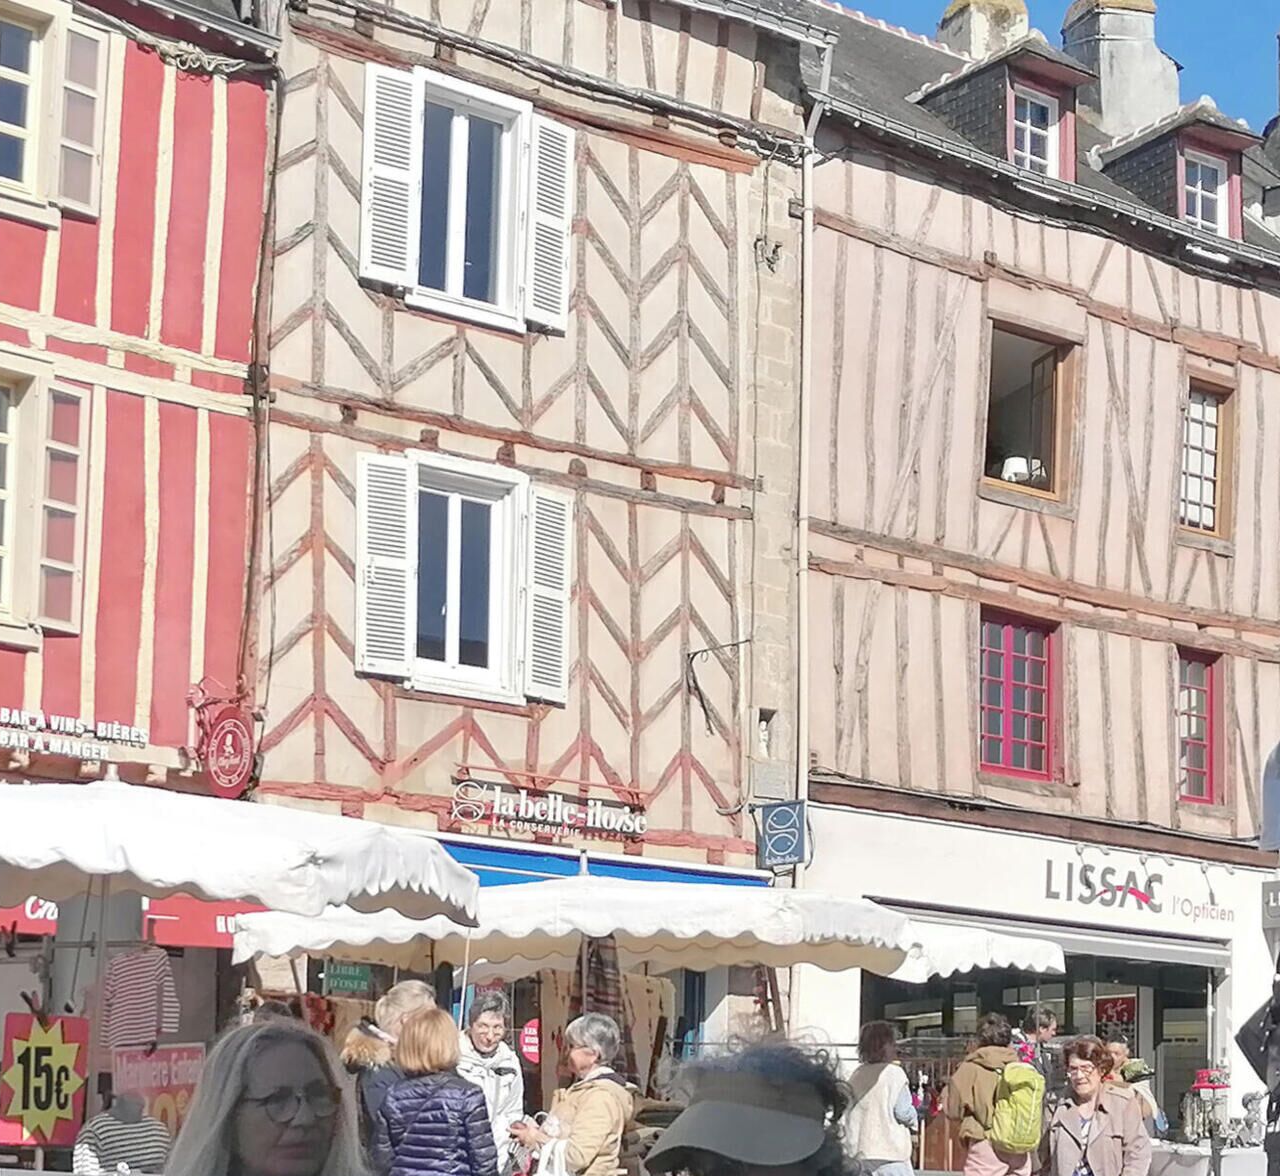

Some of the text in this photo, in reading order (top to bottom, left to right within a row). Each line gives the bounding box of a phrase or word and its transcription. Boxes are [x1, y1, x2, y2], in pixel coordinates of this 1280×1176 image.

[0, 707, 29, 725] BAR
[50, 714, 86, 734] VINS
[97, 720, 149, 743] BIÈRES
[49, 738, 109, 759] MANGER
[509, 819, 581, 837] CONSERVERIE
[519, 789, 648, 834] belle-iloise
[1045, 859, 1235, 923] LISSAC l'Opticien
[17, 1046, 70, 1111] 15€
